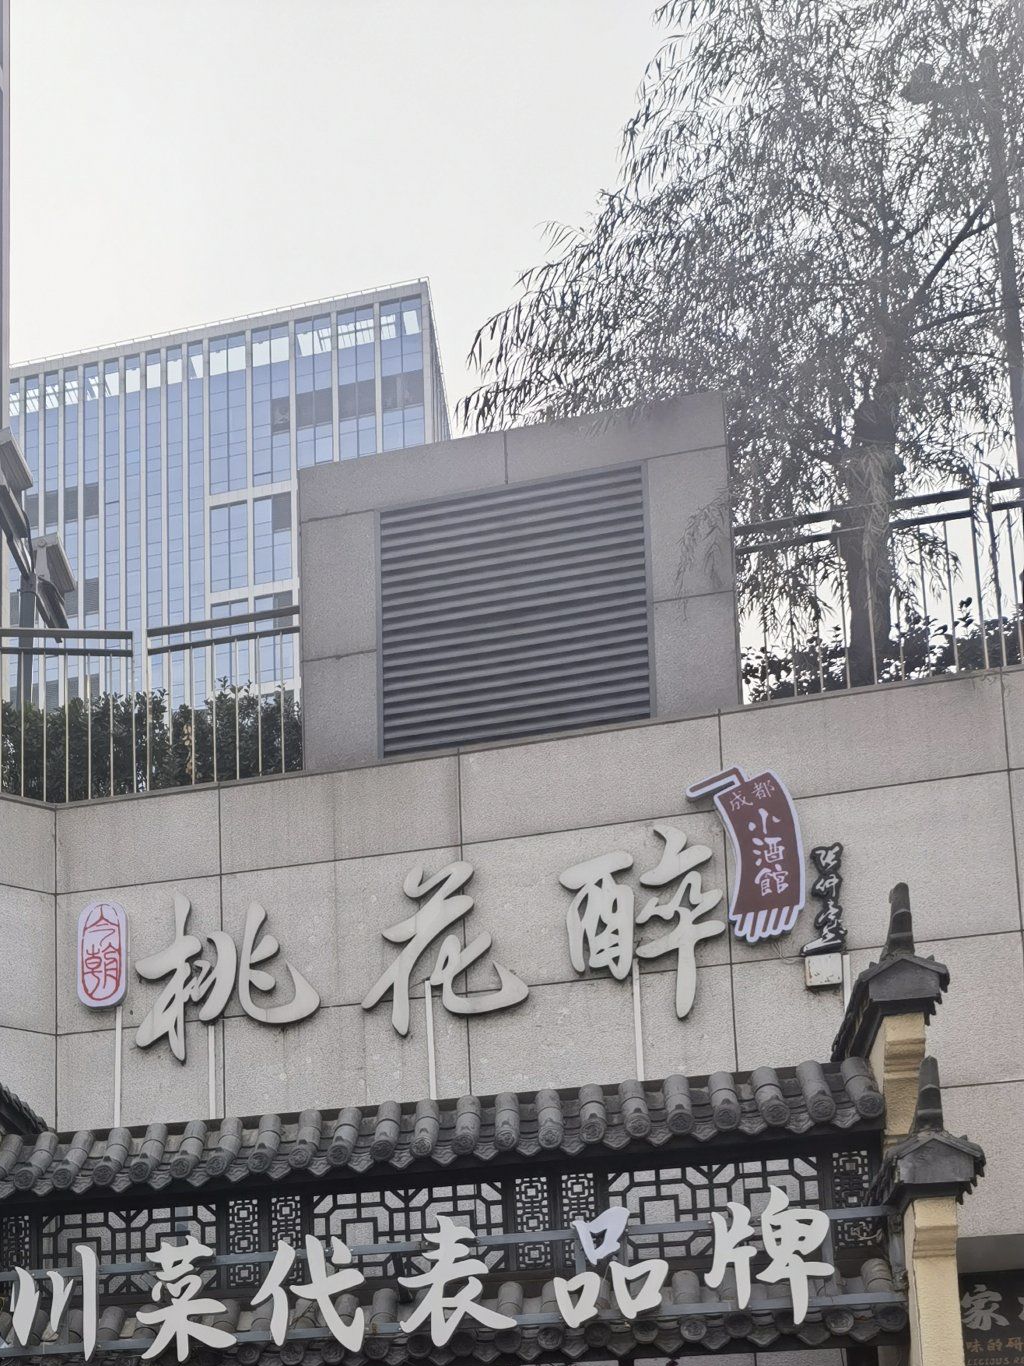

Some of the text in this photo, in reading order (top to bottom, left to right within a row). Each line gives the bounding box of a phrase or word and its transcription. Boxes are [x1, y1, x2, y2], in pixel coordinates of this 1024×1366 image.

[729, 779, 776, 812] 成都
[134, 825, 727, 1062] 桃花醉
[10, 1186, 835, 1361] 川菜代表品牌
[960, 1284, 1024, 1331] 家
